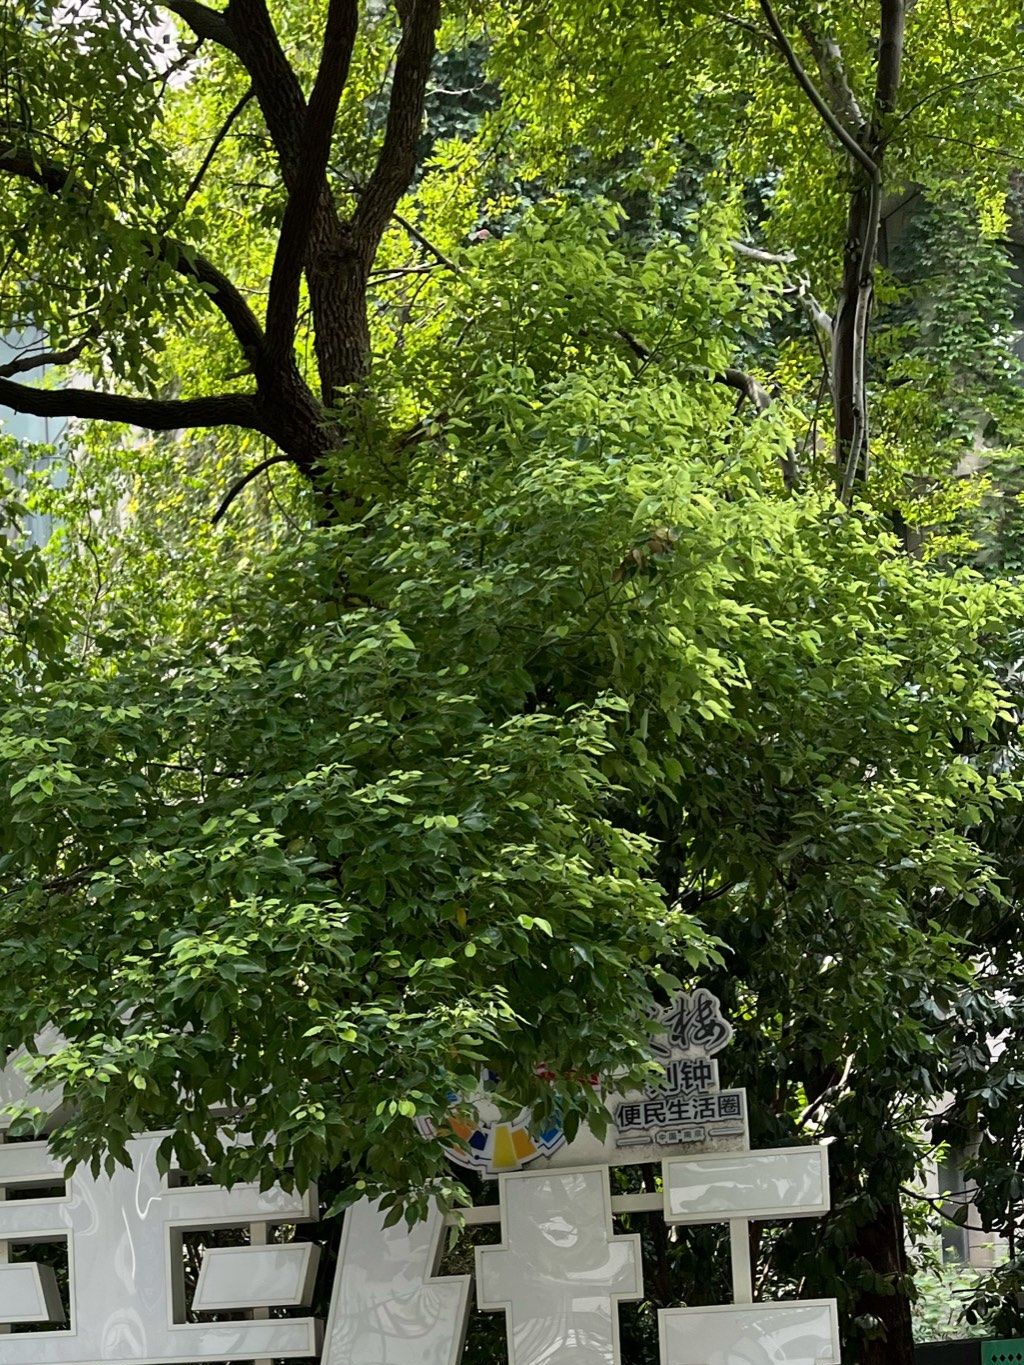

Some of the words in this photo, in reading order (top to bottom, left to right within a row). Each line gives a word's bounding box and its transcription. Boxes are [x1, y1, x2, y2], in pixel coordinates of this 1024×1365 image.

[617, 1094, 742, 1127] 便民生活圈
